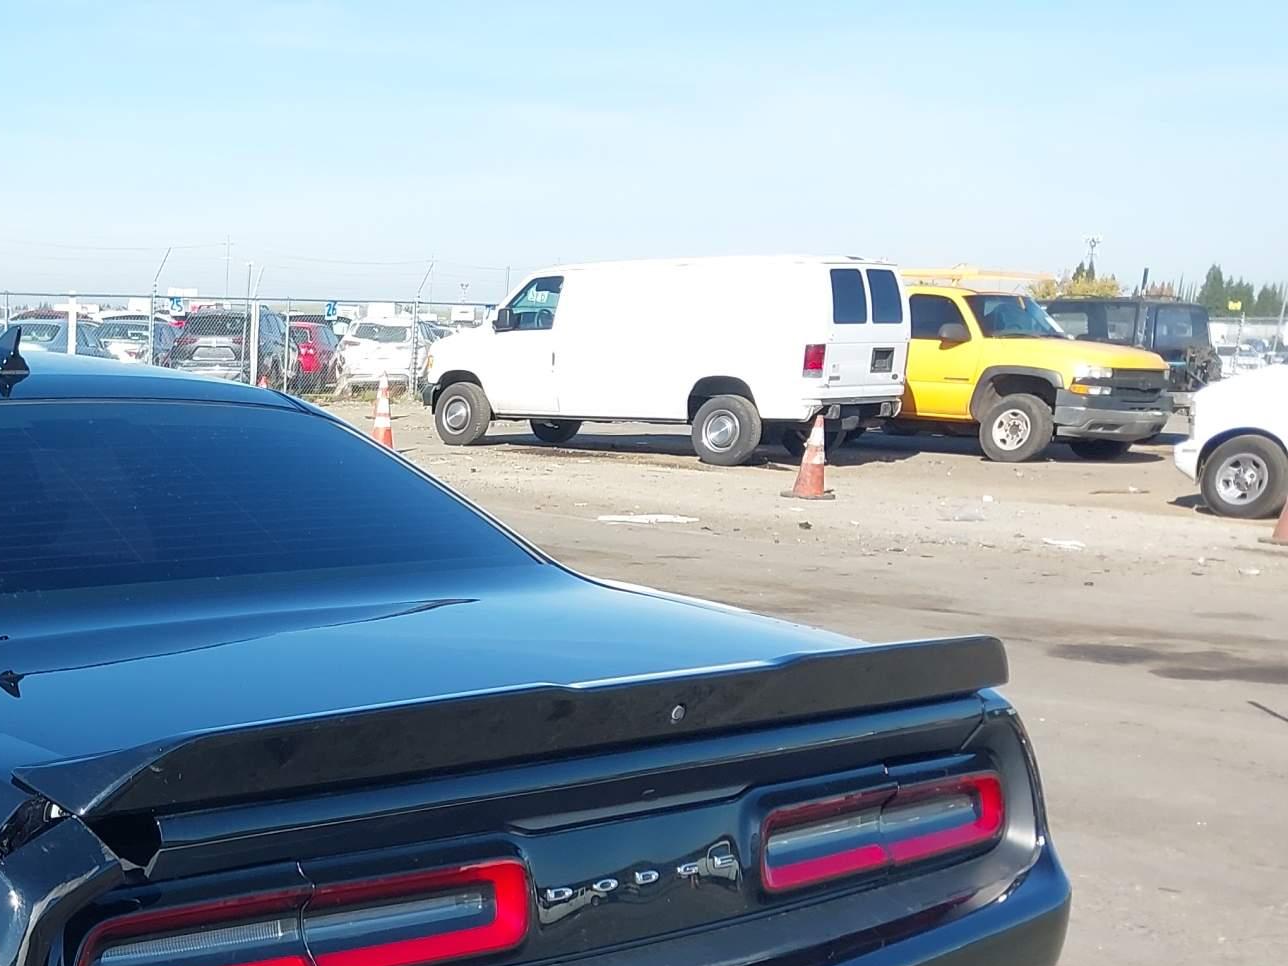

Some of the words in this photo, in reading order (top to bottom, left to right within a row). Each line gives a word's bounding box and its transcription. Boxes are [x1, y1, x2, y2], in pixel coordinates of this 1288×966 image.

[169, 296, 184, 313] 25
[325, 300, 338, 317] 26
[545, 853, 735, 902] DODGE
